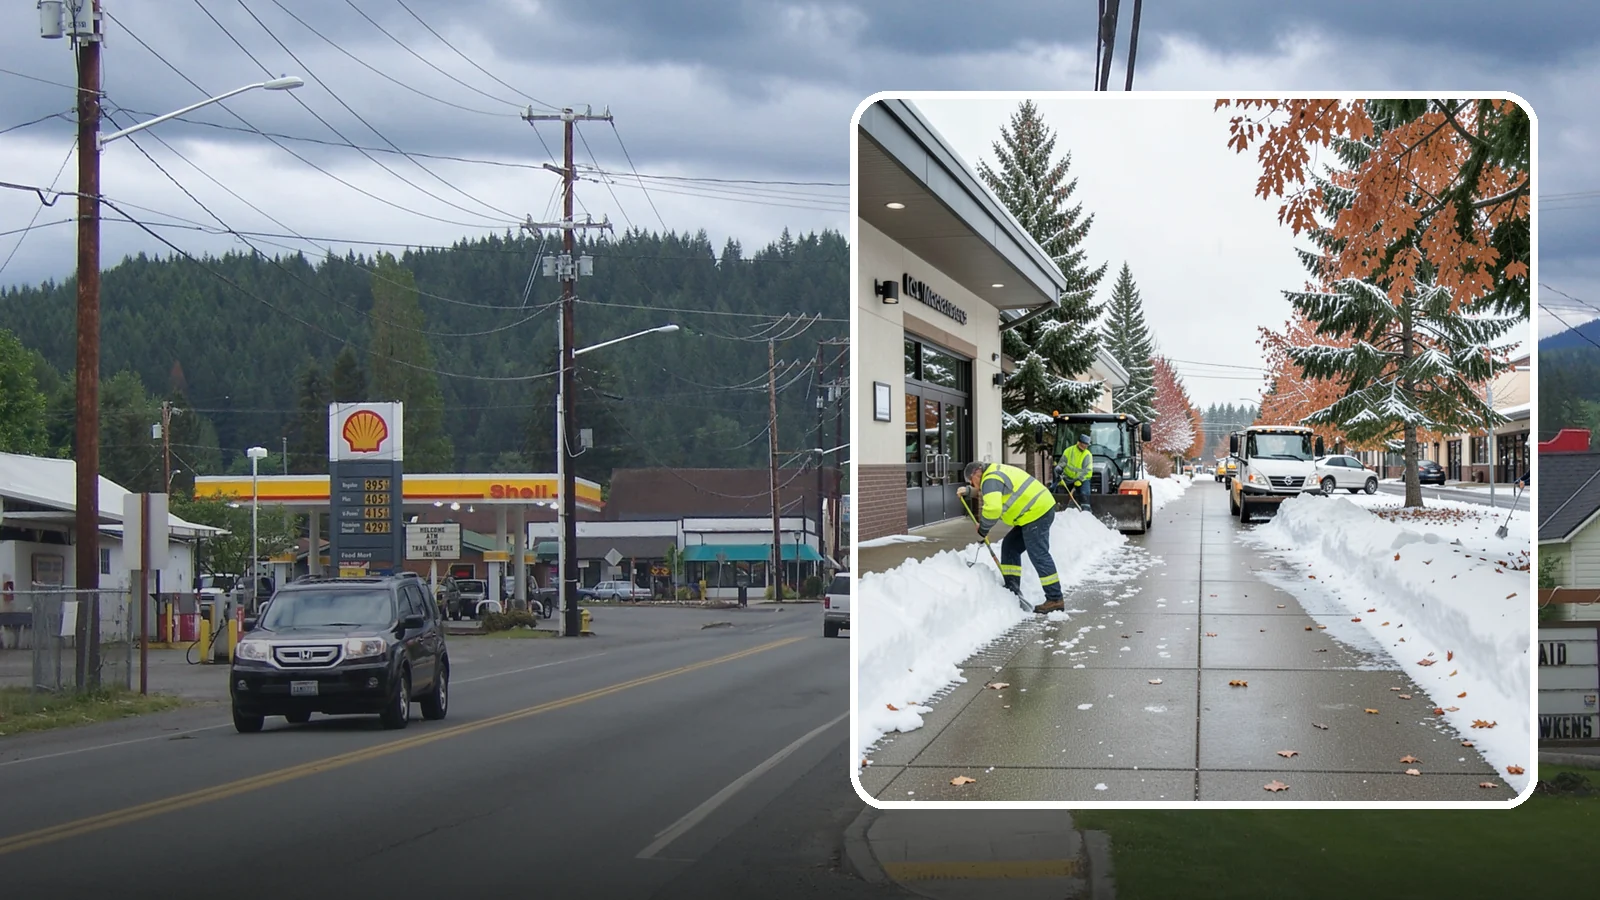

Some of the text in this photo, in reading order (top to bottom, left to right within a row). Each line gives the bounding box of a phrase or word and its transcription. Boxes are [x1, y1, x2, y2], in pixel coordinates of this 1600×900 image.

[366, 480, 383, 490] 395
[490, 484, 547, 499] Shell
[366, 494, 383, 504] 405
[366, 508, 383, 518] 415
[366, 522, 383, 533] 429
